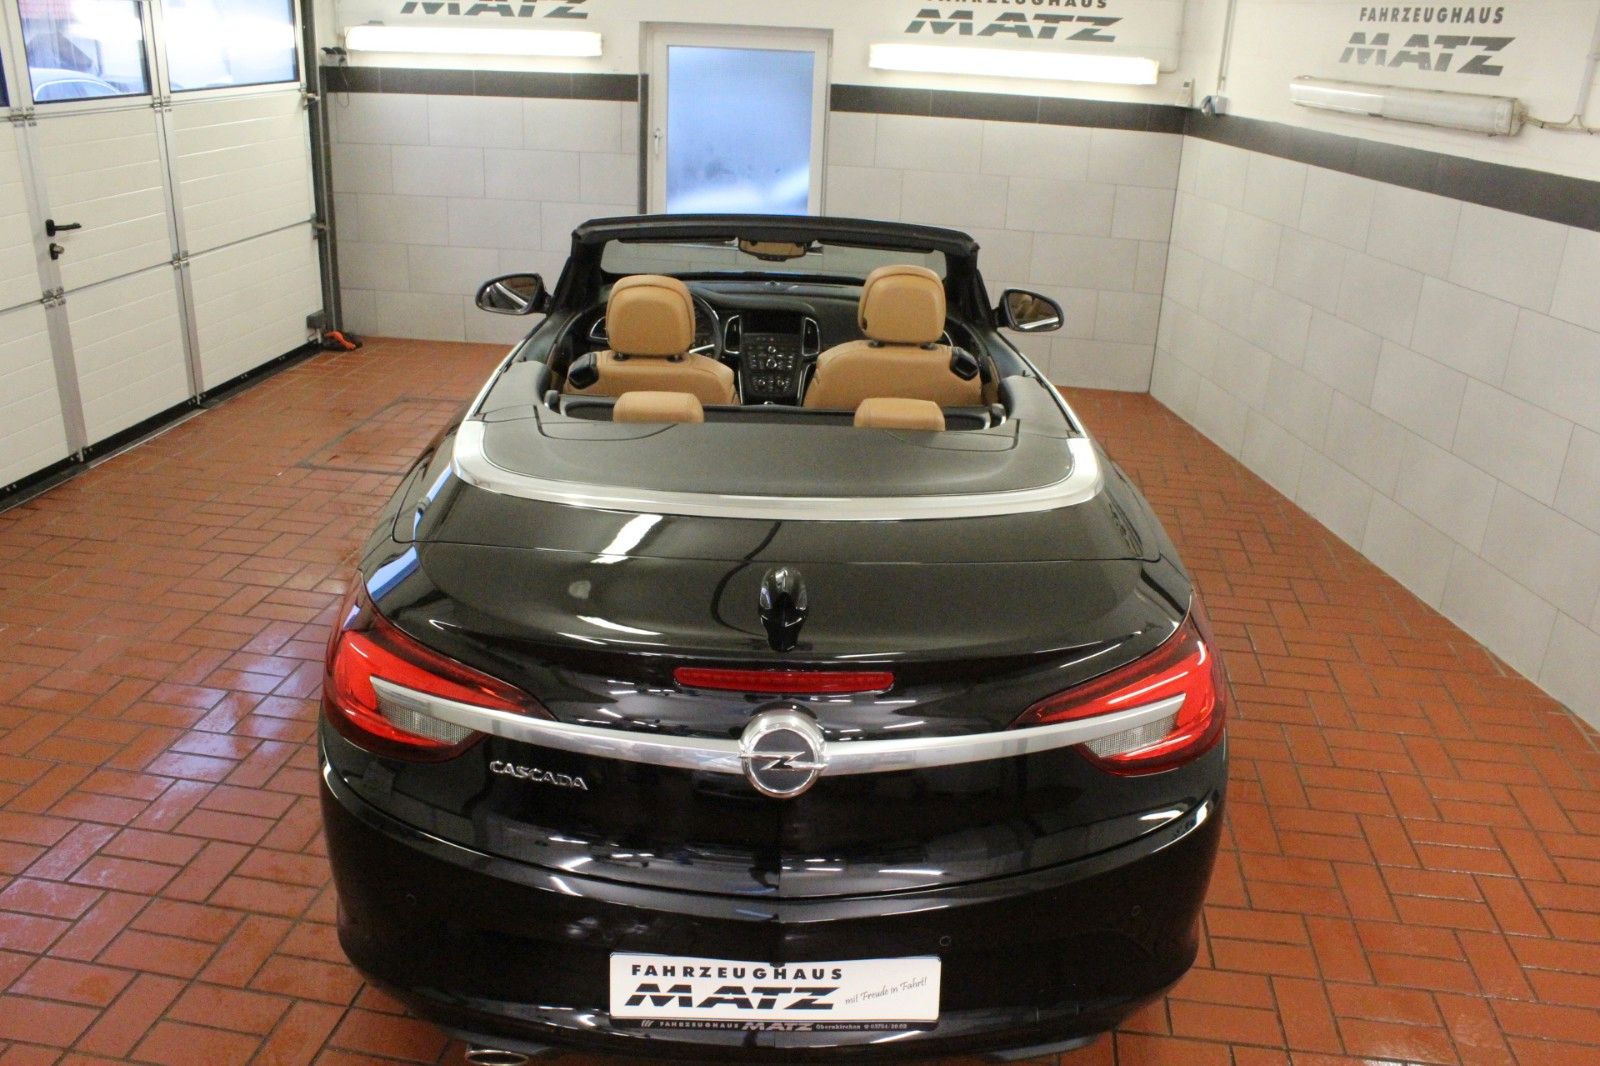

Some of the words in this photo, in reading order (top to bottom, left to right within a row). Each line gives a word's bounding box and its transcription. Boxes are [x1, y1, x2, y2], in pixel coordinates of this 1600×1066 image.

[904, 8, 1123, 42] MATZ
[1359, 6, 1505, 24] FAHRZEUGHAUS
[1338, 31, 1517, 76] MATZ
[489, 760, 589, 791] CASCADA
[632, 964, 843, 980] FAHRZEUGHAUS
[624, 983, 840, 1010] MATZ
[860, 985, 889, 1001] Freude
[899, 976, 928, 991] Fahrt!
